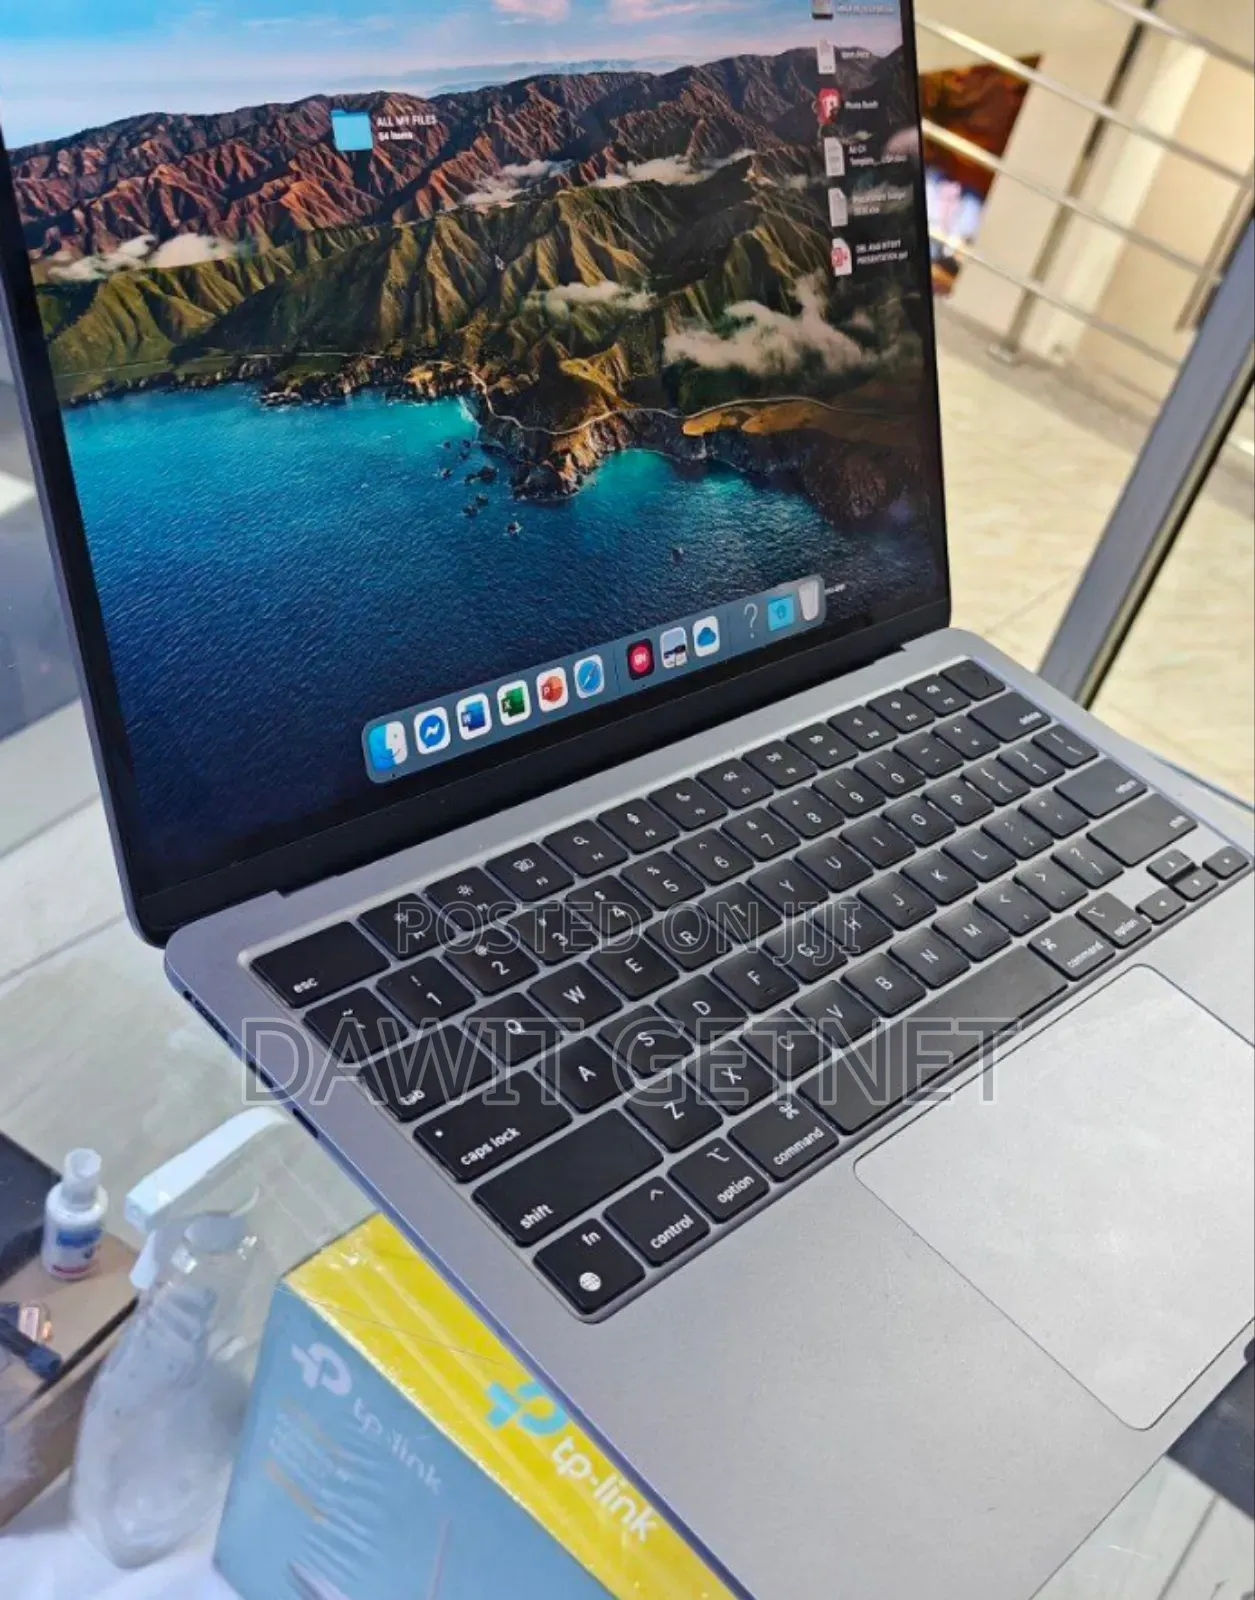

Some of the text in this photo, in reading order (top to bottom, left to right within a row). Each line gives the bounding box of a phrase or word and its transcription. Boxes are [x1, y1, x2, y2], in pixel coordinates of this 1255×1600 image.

[849, 791, 864, 803] 9
[950, 794, 963, 806] P
[806, 812, 822, 823] 8
[761, 833, 775, 846] 7
[713, 855, 729, 868] 6
[825, 857, 842, 869] U
[971, 850, 988, 861] L
[931, 869, 948, 882] K
[662, 879, 679, 892] 5
[778, 880, 794, 892] Y
[892, 893, 905, 907] J
[612, 906, 626, 918] 4
[679, 930, 698, 945] R
[962, 923, 982, 938] M
[552, 932, 569, 947] 3
[920, 948, 939, 964] N
[491, 961, 510, 976] 2
[624, 957, 643, 974] E
[293, 977, 319, 993] esc
[747, 970, 761, 986] F
[875, 975, 893, 990] B
[426, 992, 442, 1006] 1
[562, 985, 586, 1004] W
[692, 1001, 711, 1016] D
[826, 1004, 844, 1019] V
[504, 1019, 525, 1034] Q
[637, 1031, 655, 1047] S
[577, 1065, 597, 1083] A
[721, 1066, 742, 1085] X
[663, 1101, 684, 1120] Z
[460, 1126, 521, 1166] caps lock
[773, 1126, 825, 1165] command
[716, 1175, 755, 1204] option
[519, 1203, 553, 1230] shift
[581, 1229, 601, 1246] fn
[650, 1214, 695, 1249] control
[551, 1437, 658, 1544] tp-link
